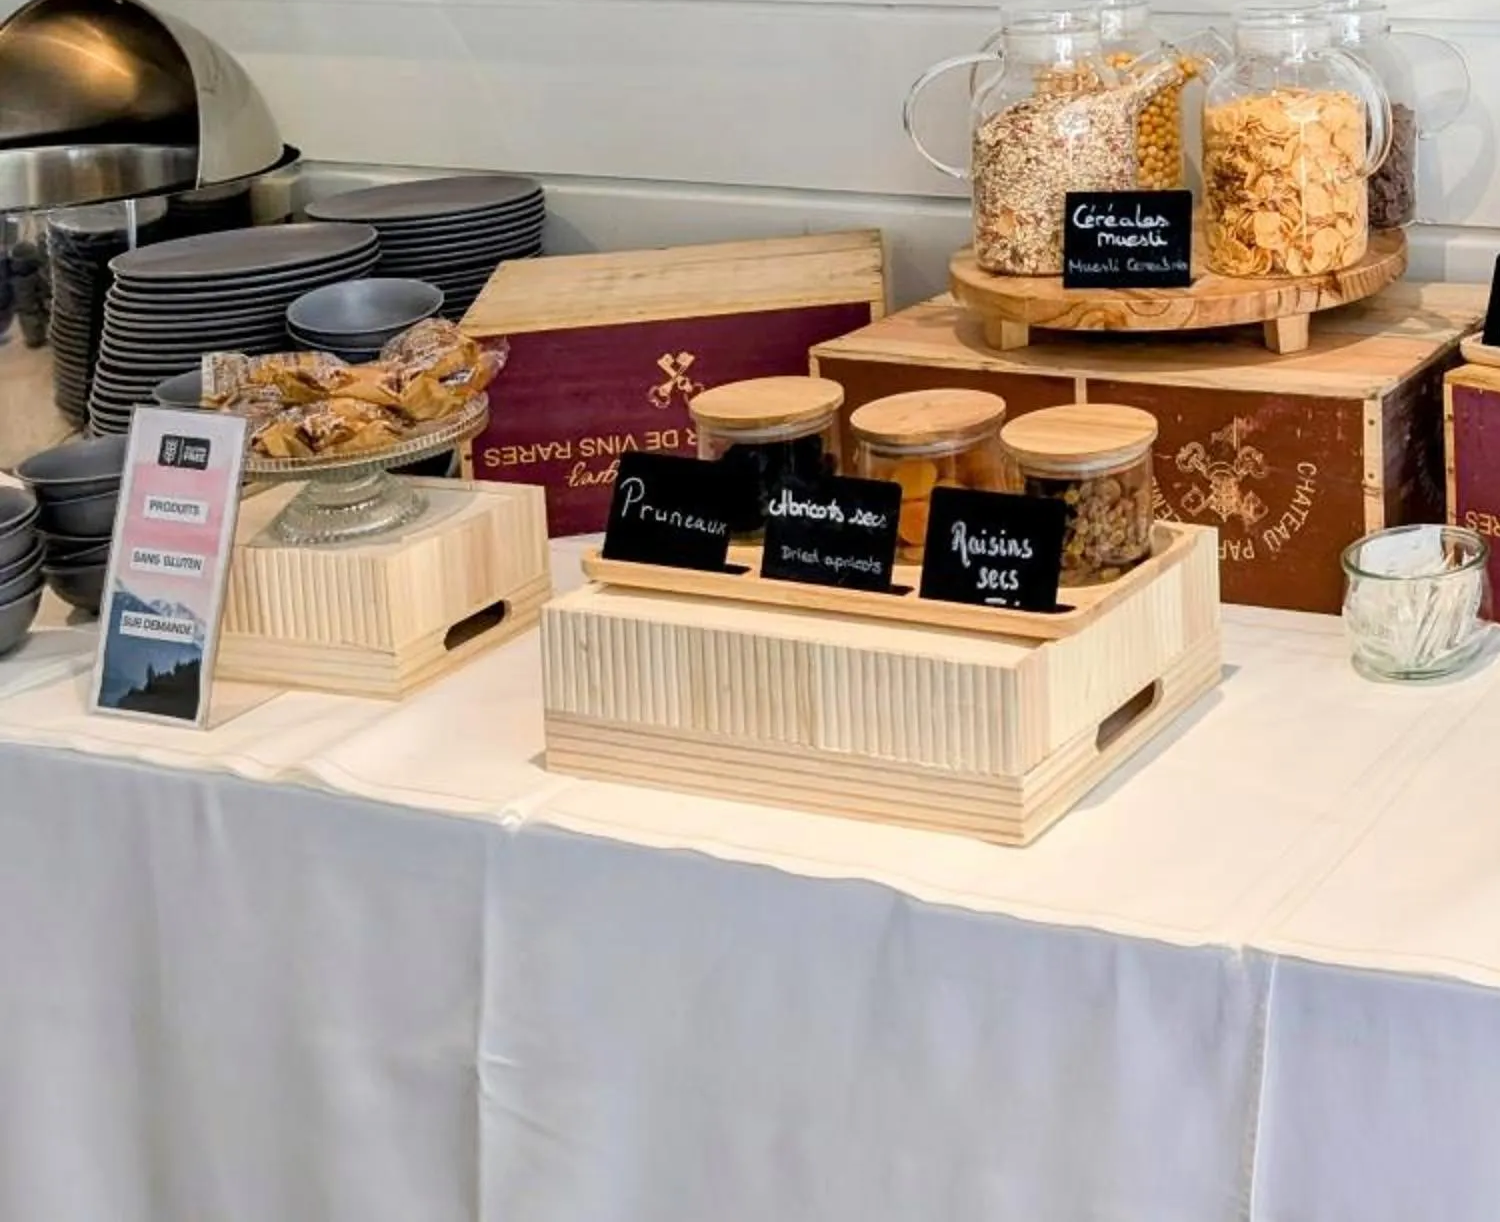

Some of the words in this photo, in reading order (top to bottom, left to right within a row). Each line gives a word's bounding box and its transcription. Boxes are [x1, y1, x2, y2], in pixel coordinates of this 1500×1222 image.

[483, 440, 572, 468] RARES
[579, 433, 639, 459] VINS
[149, 499, 201, 517] PRODUITS
[620, 477, 728, 537] Pruneaux
[1263, 461, 1318, 553] CHATEAU
[950, 520, 1034, 568] Raisins
[133, 550, 161, 566] SANS
[163, 554, 203, 572] GLUTEN
[976, 566, 1020, 591] secs
